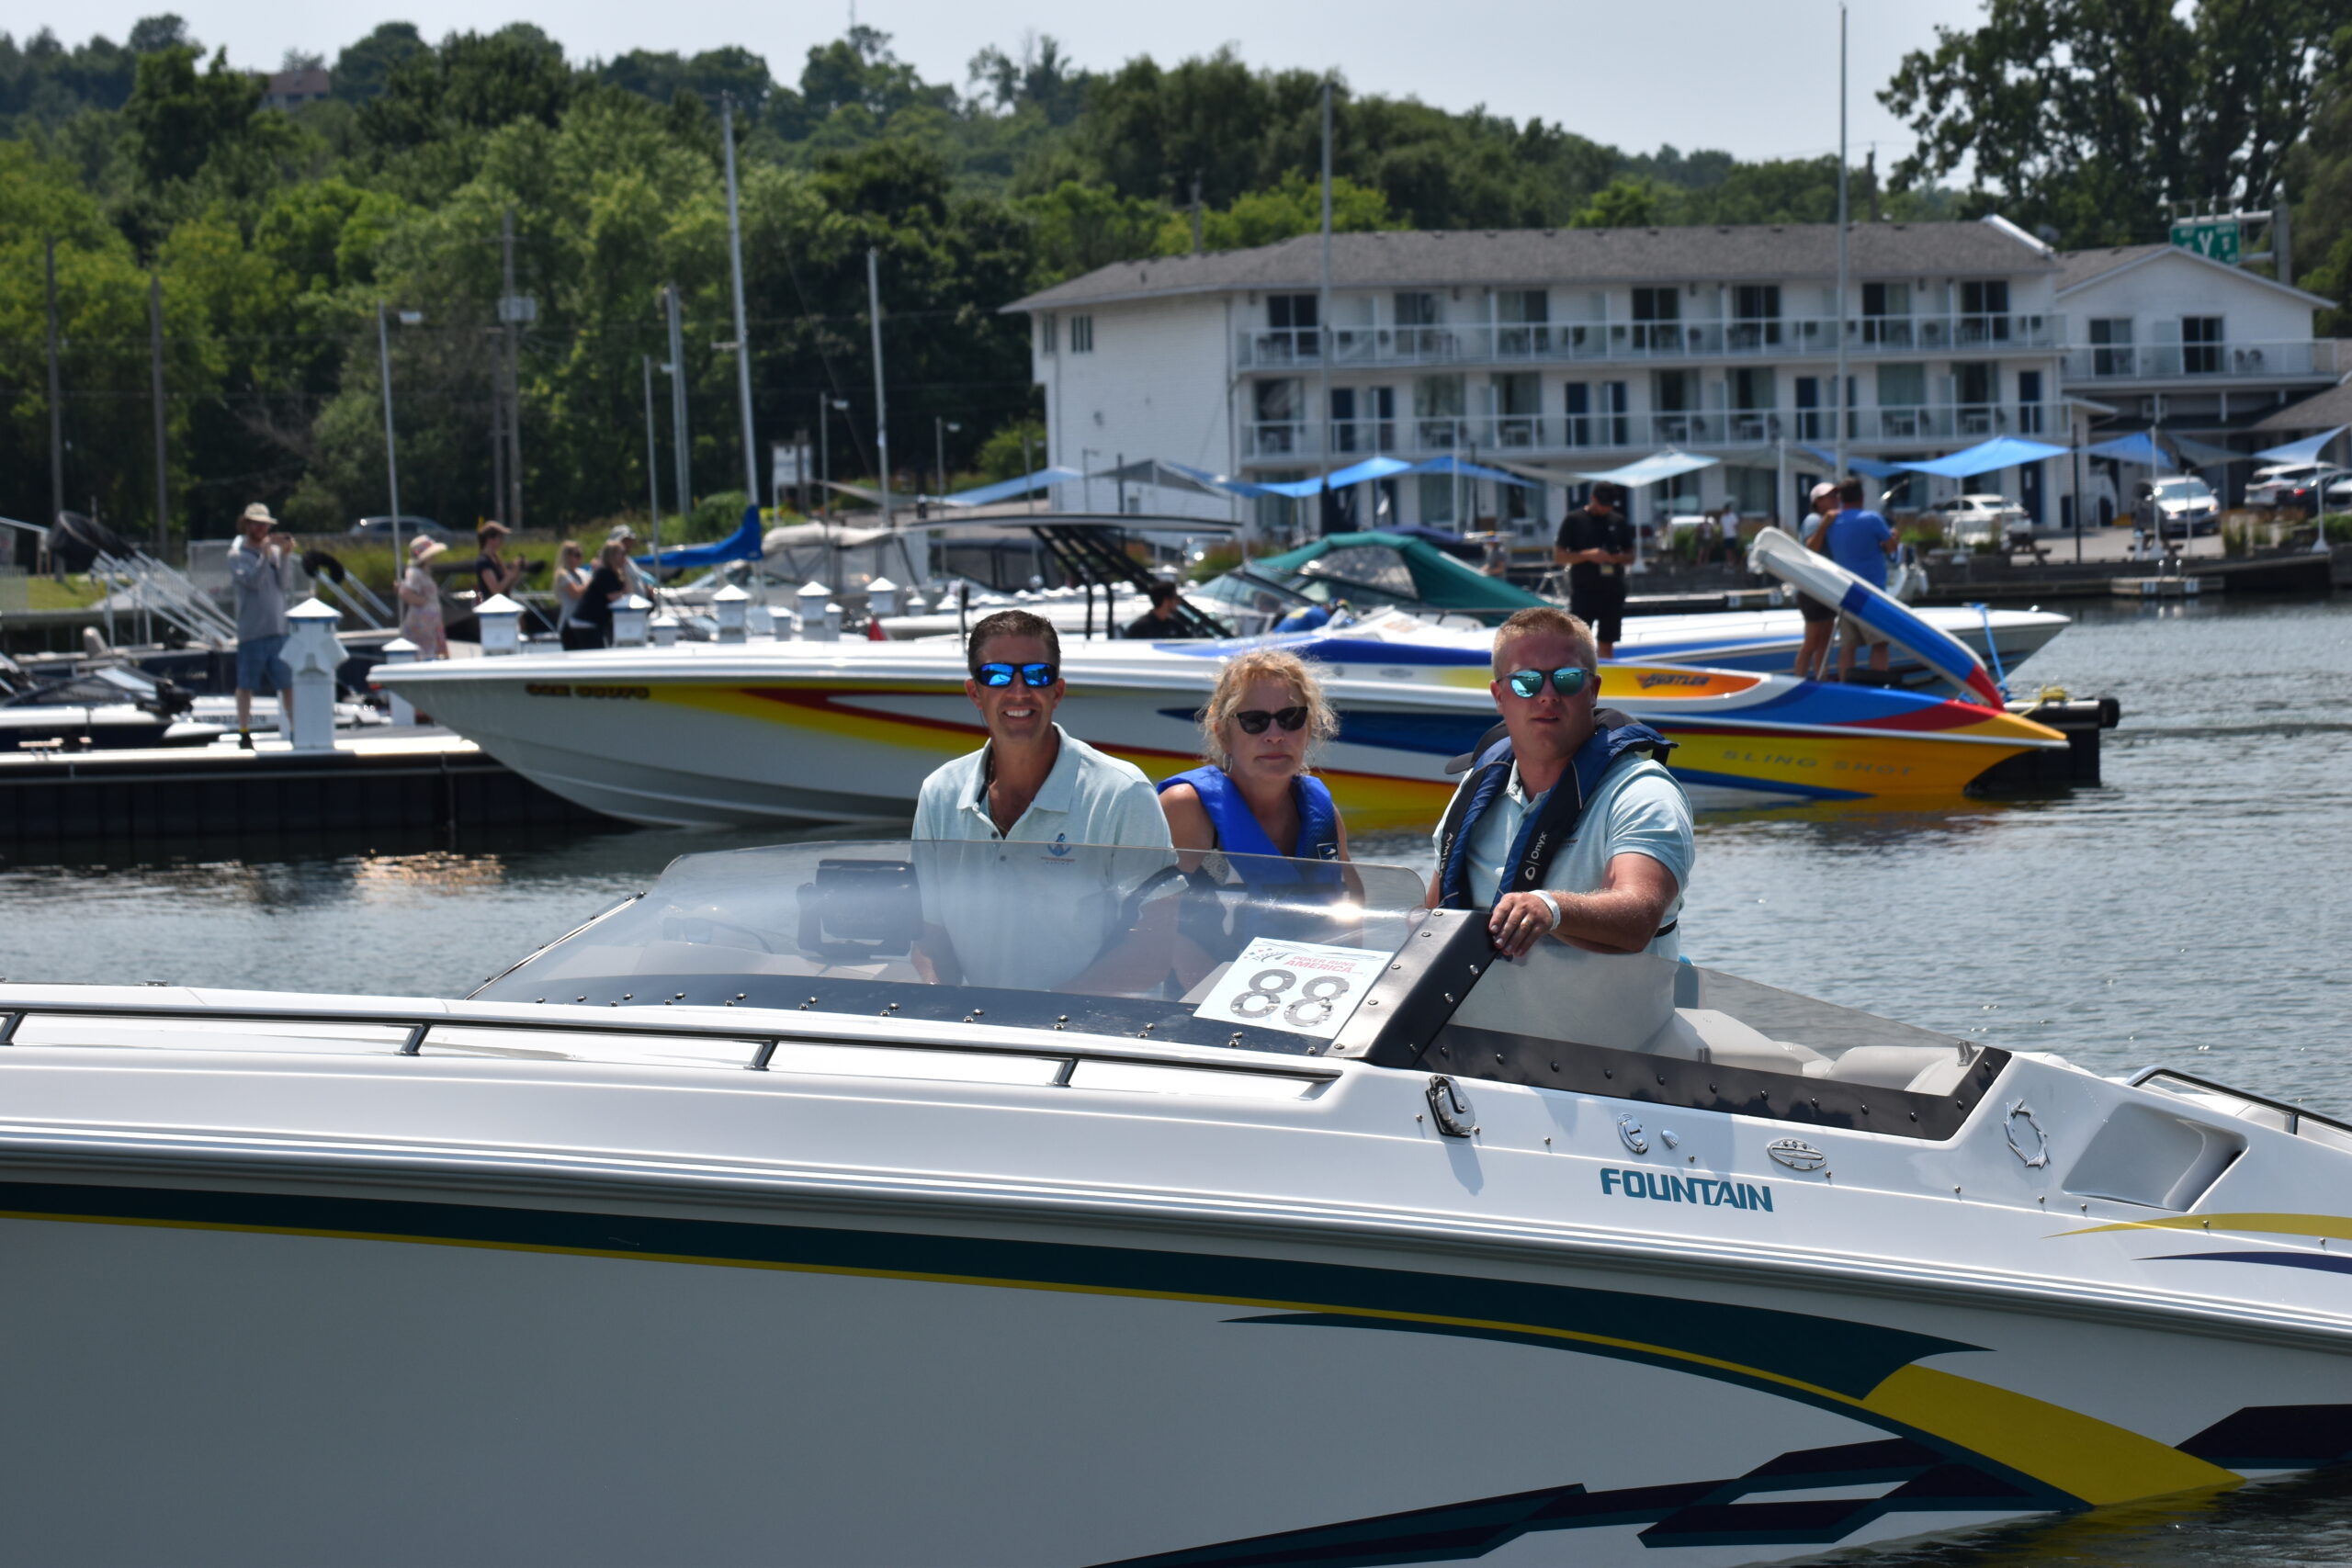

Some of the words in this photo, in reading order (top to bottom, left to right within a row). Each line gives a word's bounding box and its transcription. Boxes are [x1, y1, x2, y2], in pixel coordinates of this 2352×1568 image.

[1722, 750, 1817, 768] SLING
[1832, 761, 1916, 776] SHOT
[1531, 830, 1548, 860] Onyx
[1283, 961, 1353, 974] AMERICA
[1293, 955, 1326, 964] POKER
[1328, 959, 1357, 967] RUNS
[1229, 968, 1351, 1028] 88
[1600, 1168, 1774, 1213] FOUNTAIN
